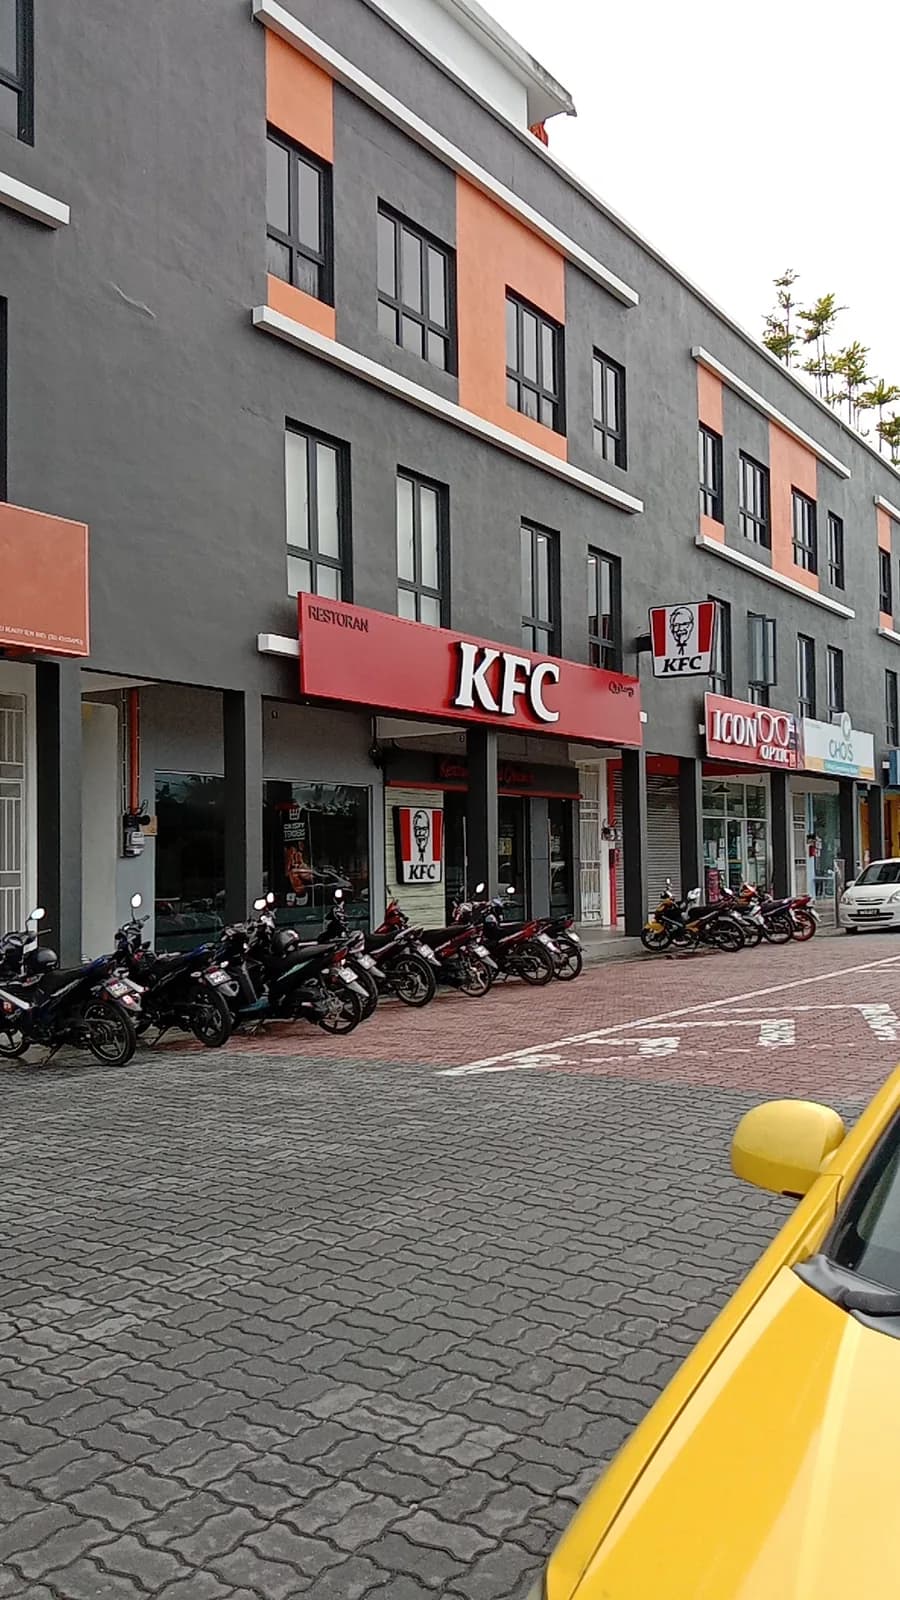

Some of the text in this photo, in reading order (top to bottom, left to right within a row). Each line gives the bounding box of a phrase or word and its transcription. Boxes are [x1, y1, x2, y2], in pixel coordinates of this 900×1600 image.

[307, 604, 369, 633] RESTORAN
[662, 655, 703, 673] KFC
[454, 641, 560, 722] KFC
[712, 709, 757, 748] ICON
[761, 744, 789, 763] OPTIC
[408, 863, 436, 880] KFC
